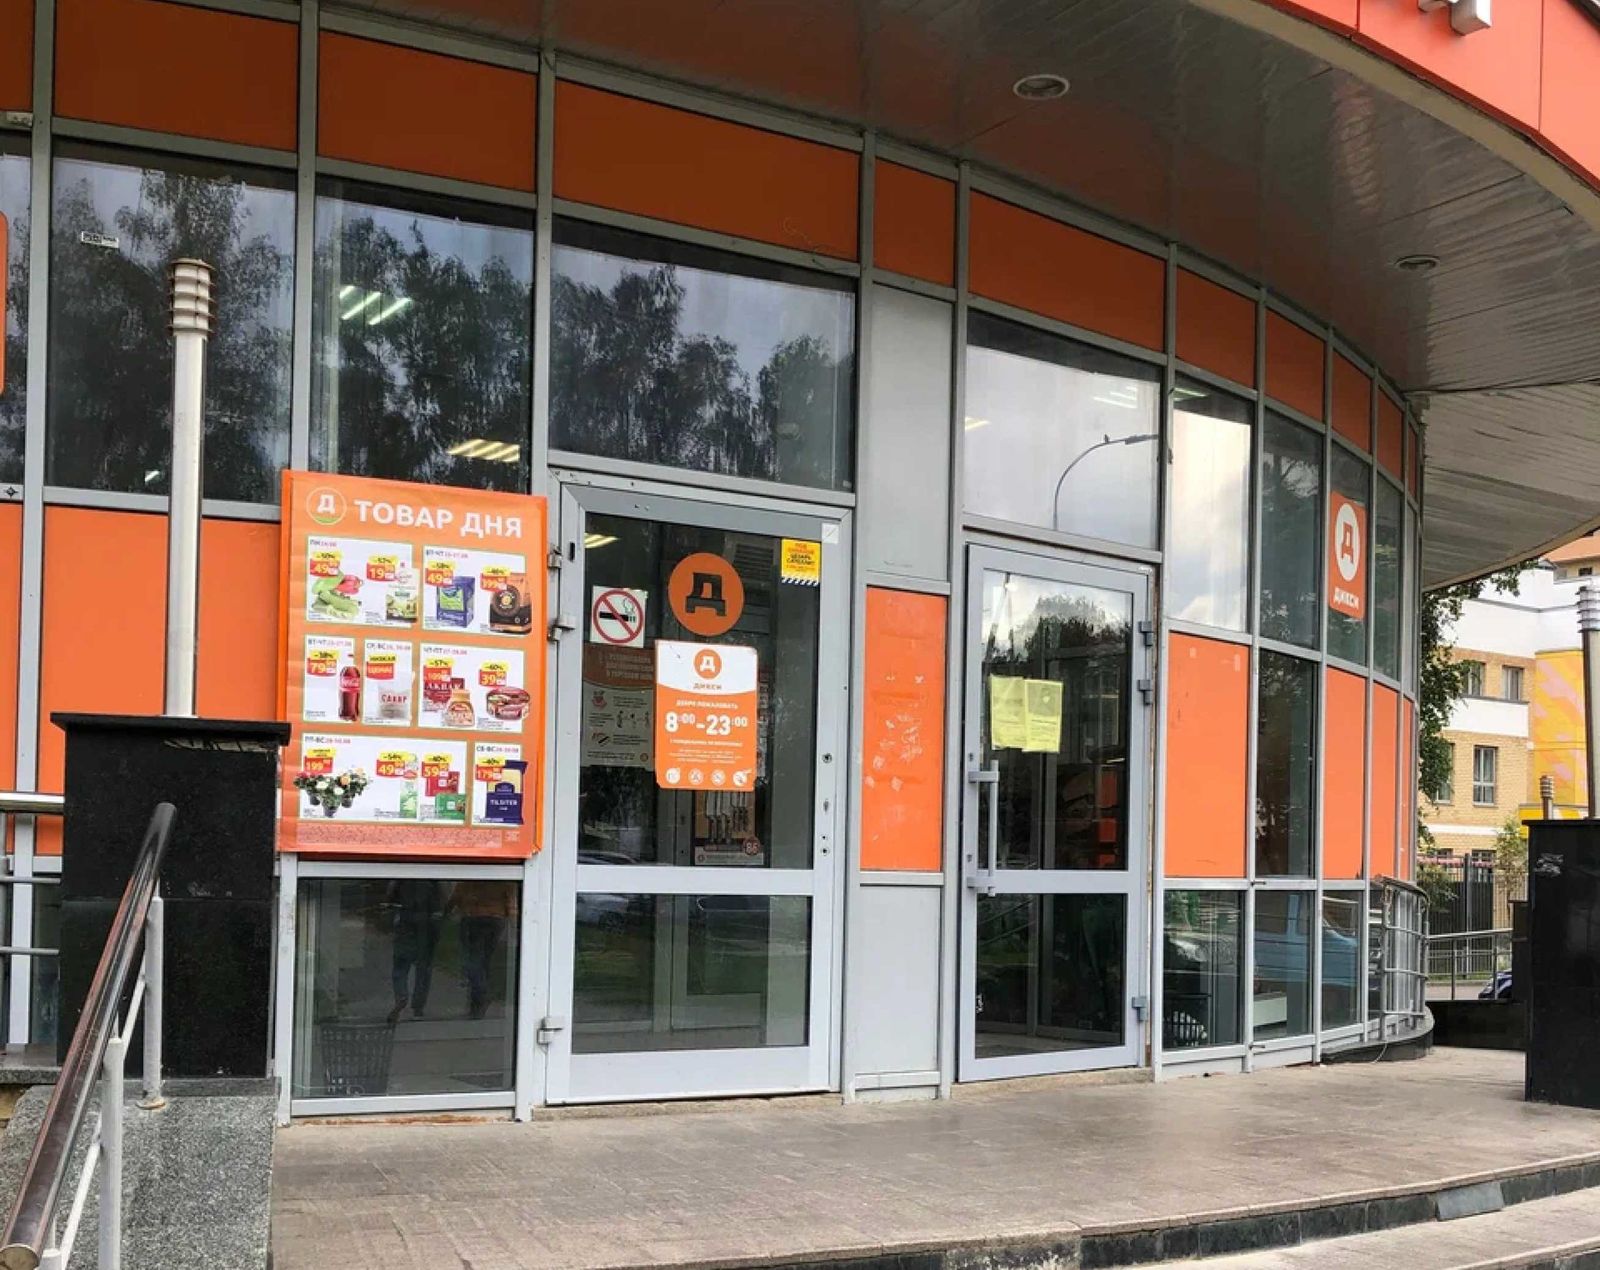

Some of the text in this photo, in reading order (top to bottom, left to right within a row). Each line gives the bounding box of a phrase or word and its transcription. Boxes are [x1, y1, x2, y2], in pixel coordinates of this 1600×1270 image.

[354, 500, 522, 539] ТОВАР ДНЯ
[1341, 522, 1354, 564] Д
[686, 572, 726, 616] Д
[310, 663, 326, 674] 79
[699, 656, 716, 673] Д
[482, 674, 496, 685] 39
[379, 764, 394, 776] 49
